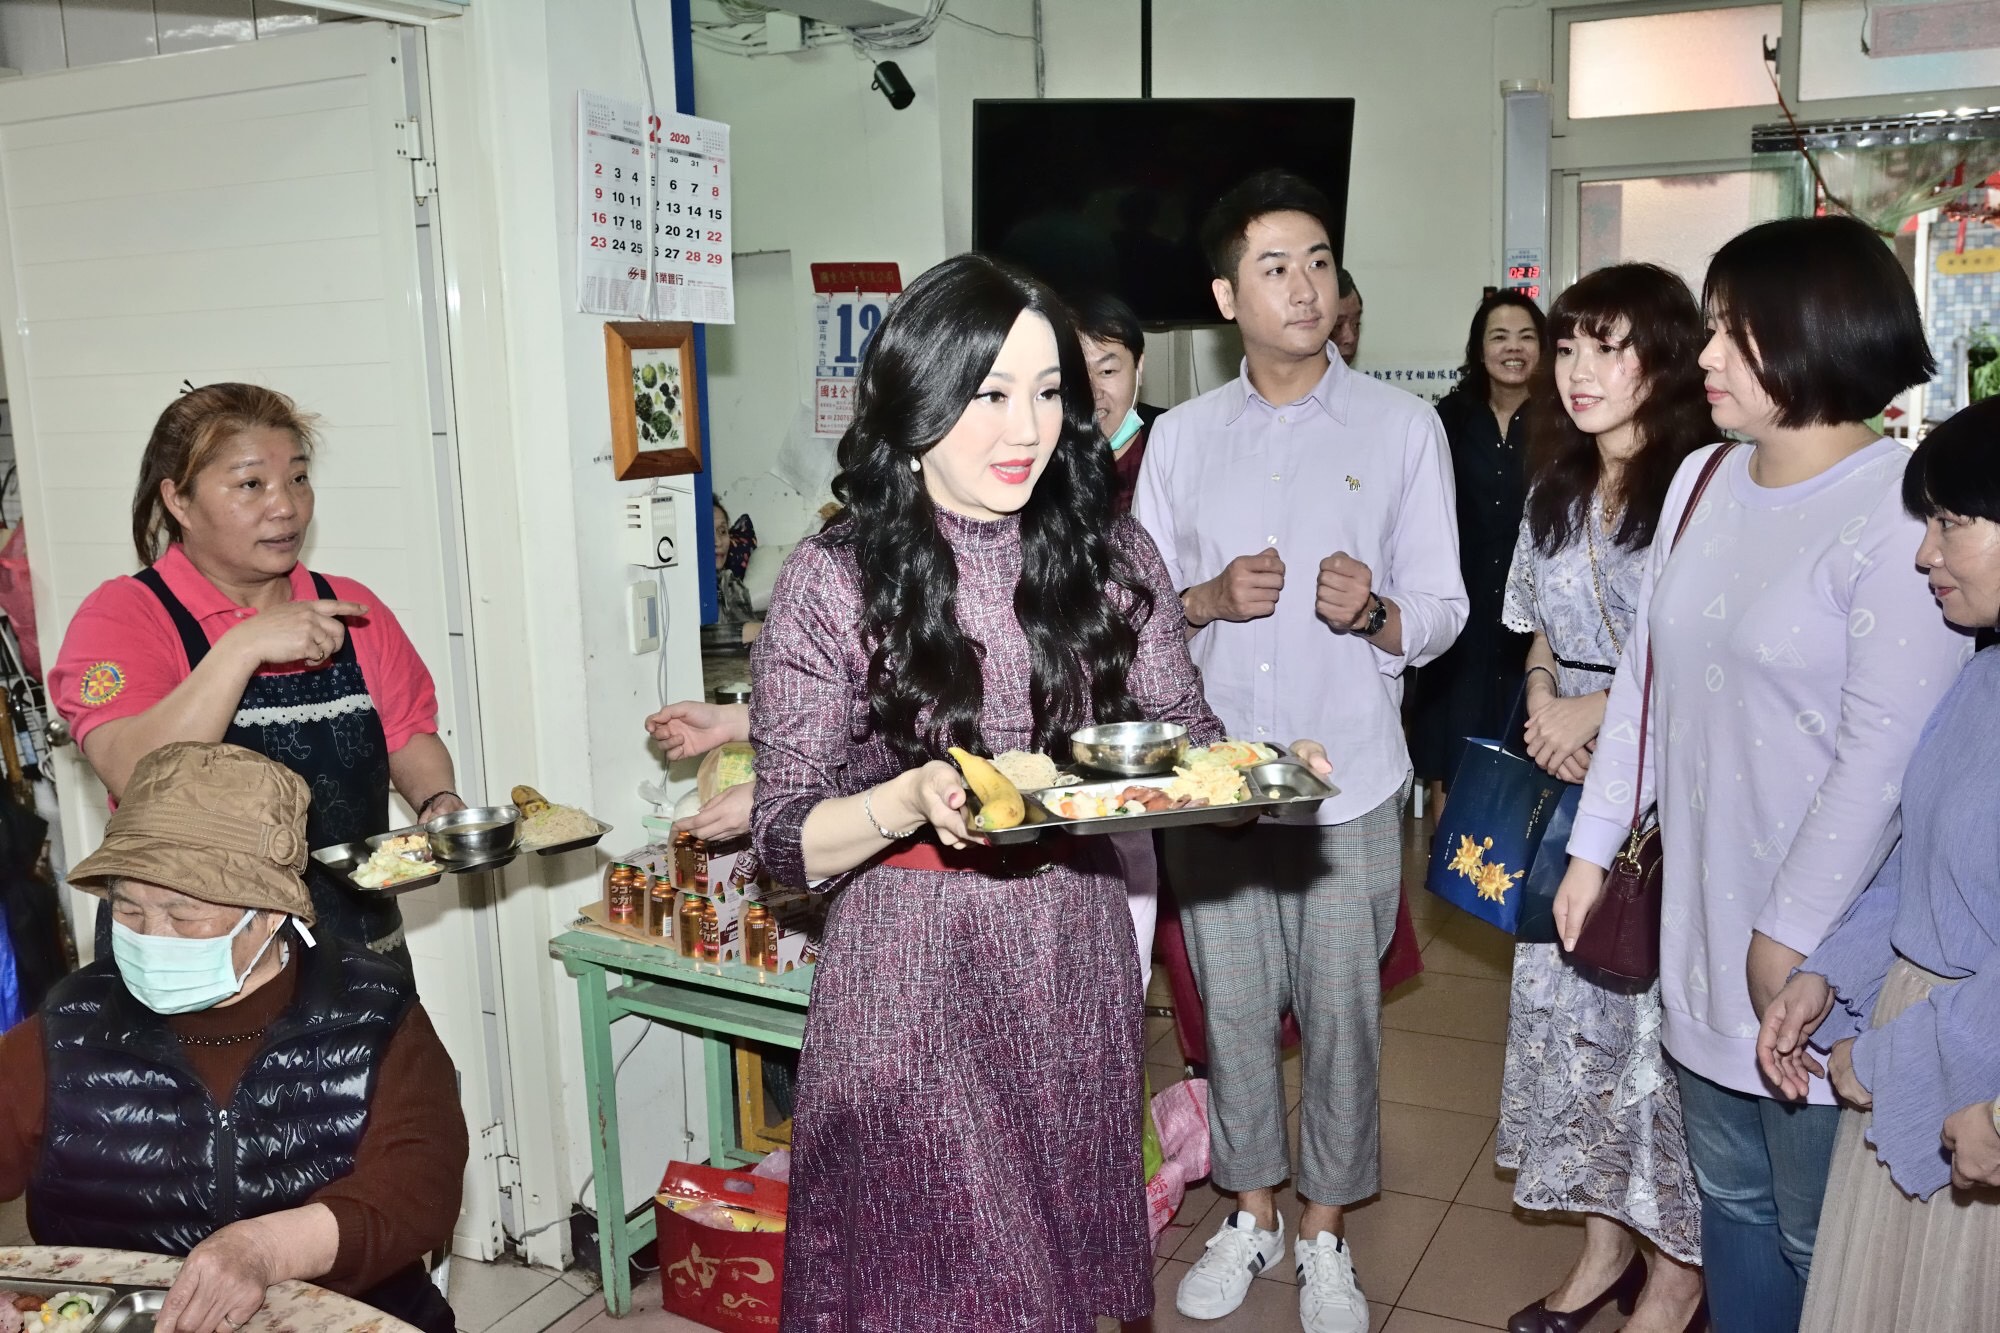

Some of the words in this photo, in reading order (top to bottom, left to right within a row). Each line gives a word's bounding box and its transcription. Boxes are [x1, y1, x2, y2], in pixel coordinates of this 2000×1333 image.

[648, 115, 662, 144] 2
[670, 132, 690, 144] 2020
[631, 147, 640, 155] 28
[669, 156, 679, 164] 30
[690, 159, 700, 167] 31
[712, 164, 719, 174] 1
[594, 163, 602, 175] 2
[614, 167, 622, 179] 3
[631, 172, 639, 183] 4
[669, 179, 678, 191] 6
[690, 182, 699, 194] 7
[711, 186, 720, 198] 8
[594, 187, 603, 199] 9
[612, 191, 625, 204] 10
[629, 195, 642, 207] 11
[666, 202, 681, 214] 13
[687, 205, 702, 217] 14
[708, 208, 723, 220] 15
[591, 211, 607, 224] 16
[612, 215, 625, 227] 17
[630, 219, 642, 231] 18
[665, 225, 681, 237] 20
[686, 228, 701, 240] 21
[707, 231, 722, 243] 22
[590, 236, 607, 249] 23
[612, 238, 626, 251] 24
[630, 241, 643, 254] 25
[664, 247, 680, 260] 27
[686, 250, 701, 262] 28
[707, 253, 723, 265] 29
[818, 325, 827, 366] 正月十九日
